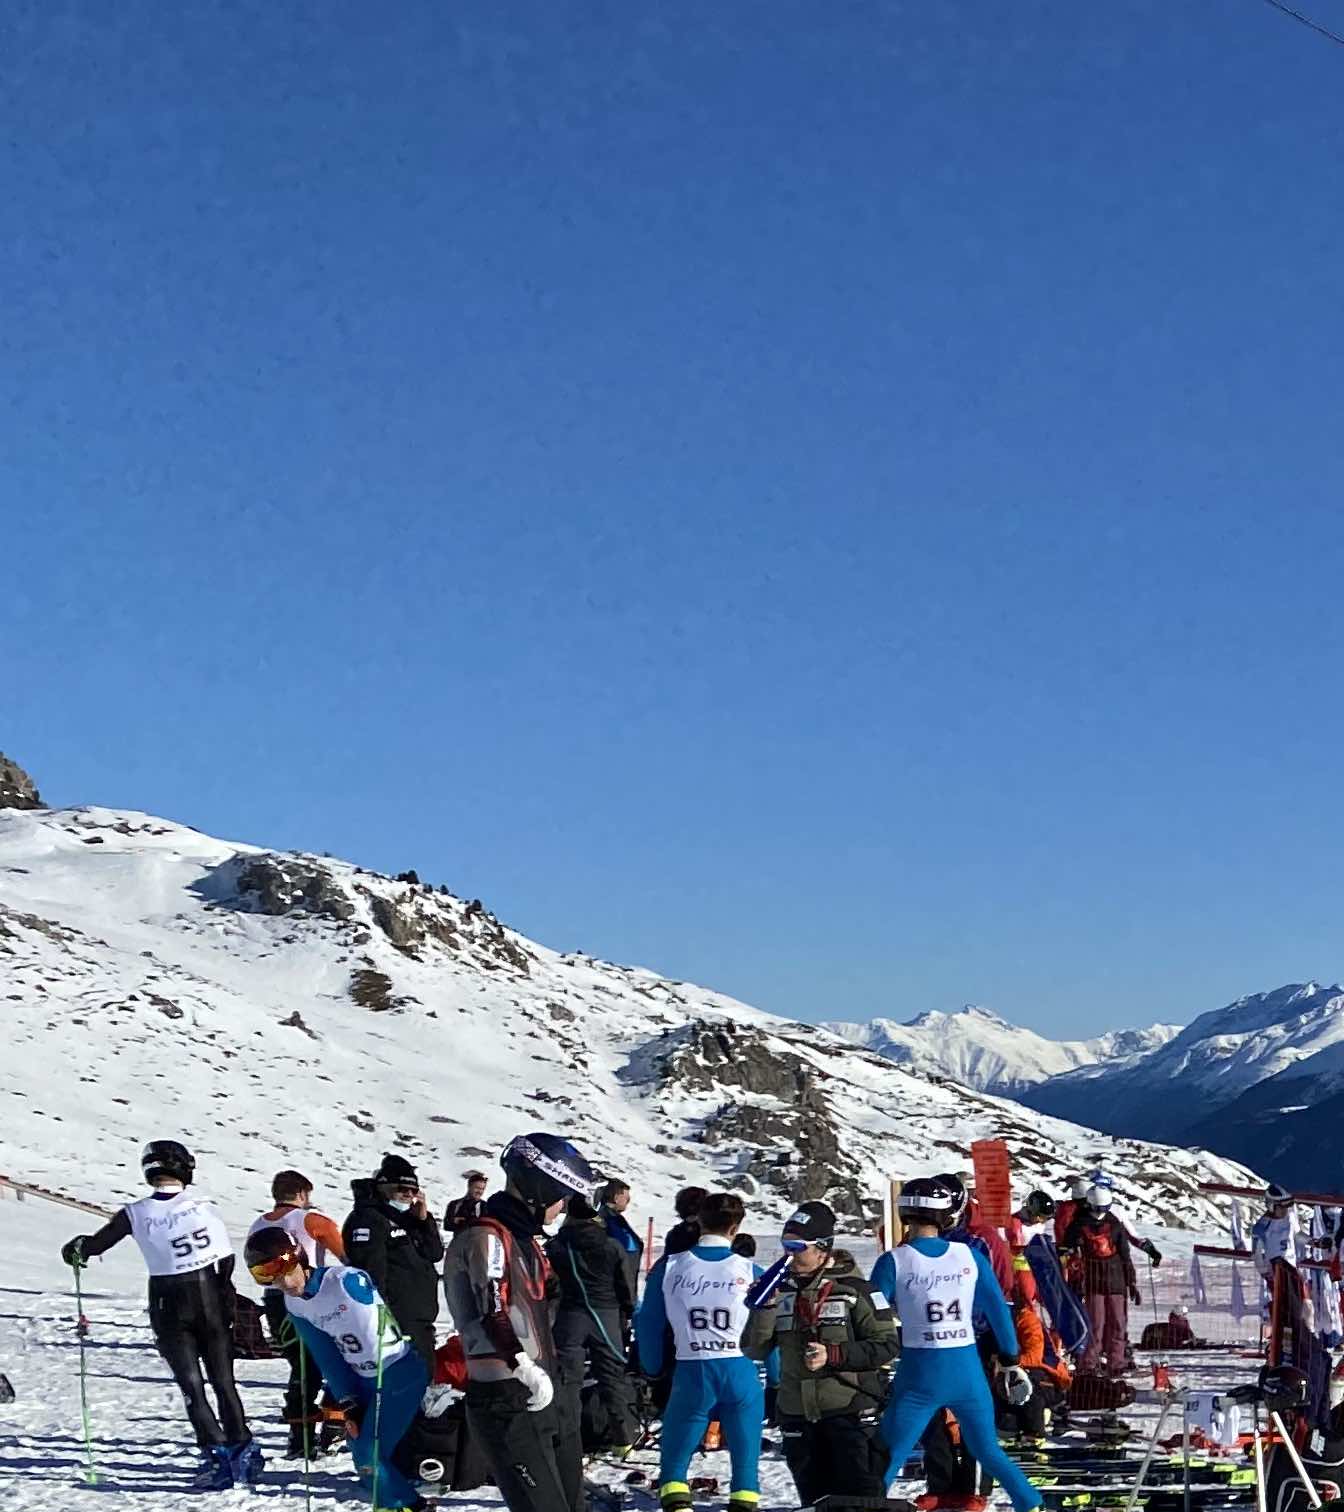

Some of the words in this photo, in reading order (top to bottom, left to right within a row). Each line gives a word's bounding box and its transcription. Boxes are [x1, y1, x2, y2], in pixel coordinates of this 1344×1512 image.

[170, 1226, 212, 1258] 55
[690, 1306, 731, 1331] 60
[926, 1299, 962, 1323] 64
[921, 1328, 967, 1342] suva
